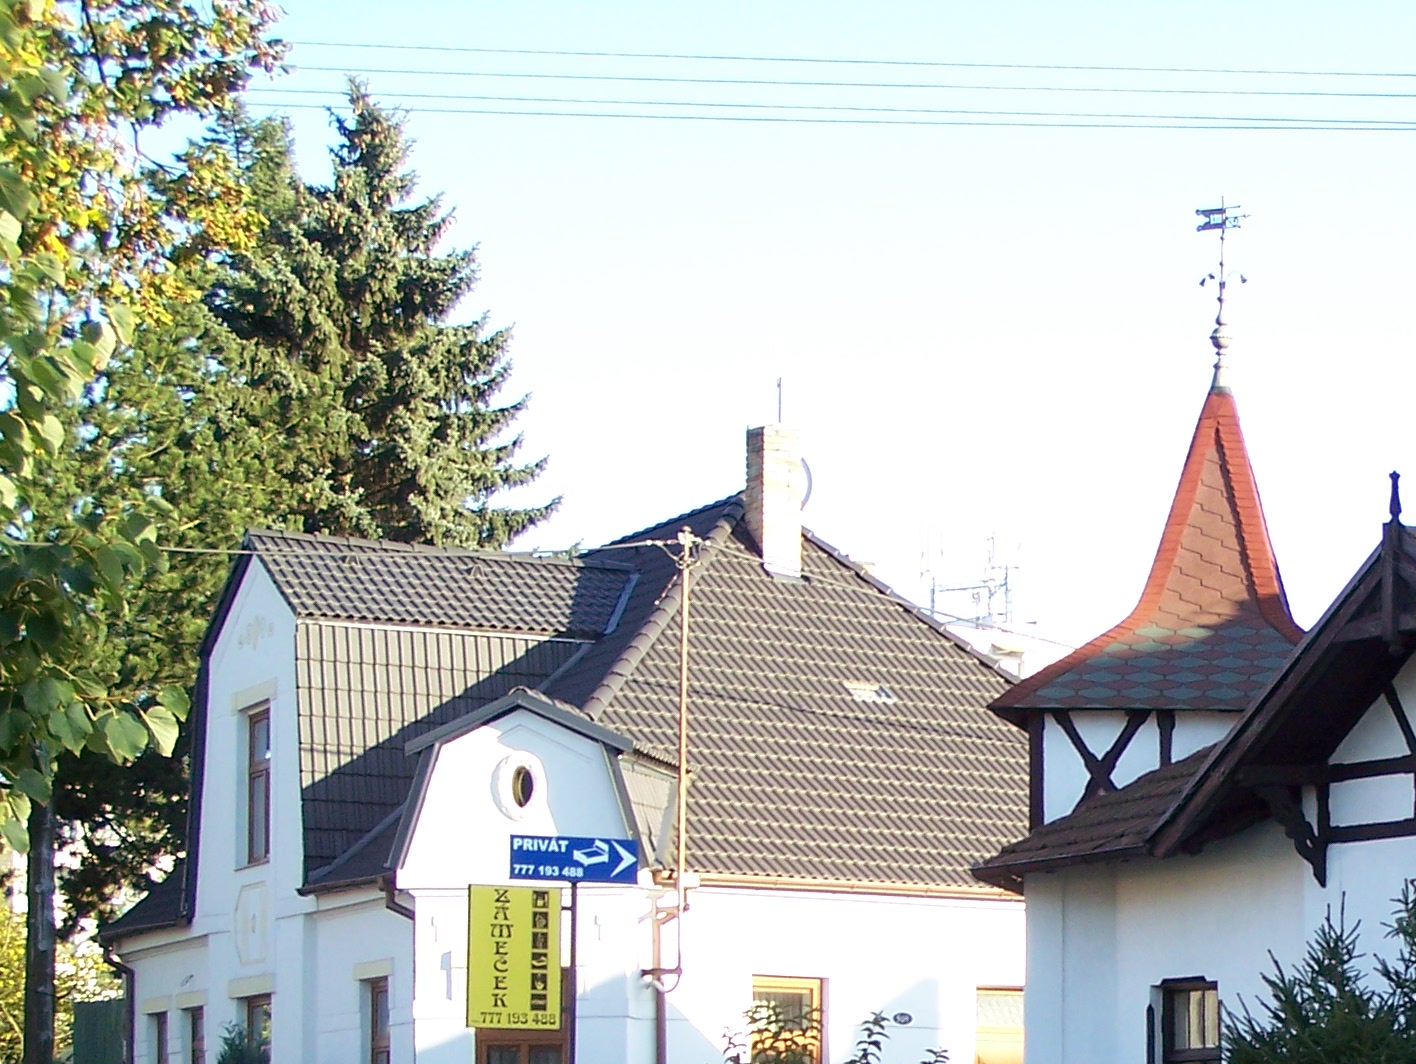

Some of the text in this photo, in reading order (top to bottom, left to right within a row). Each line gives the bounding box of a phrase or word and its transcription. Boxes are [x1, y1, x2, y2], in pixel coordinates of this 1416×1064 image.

[513, 837, 569, 853] PRIVÁT
[513, 863, 584, 878] 777 193 488
[480, 1012, 556, 1026] 777 193 488
